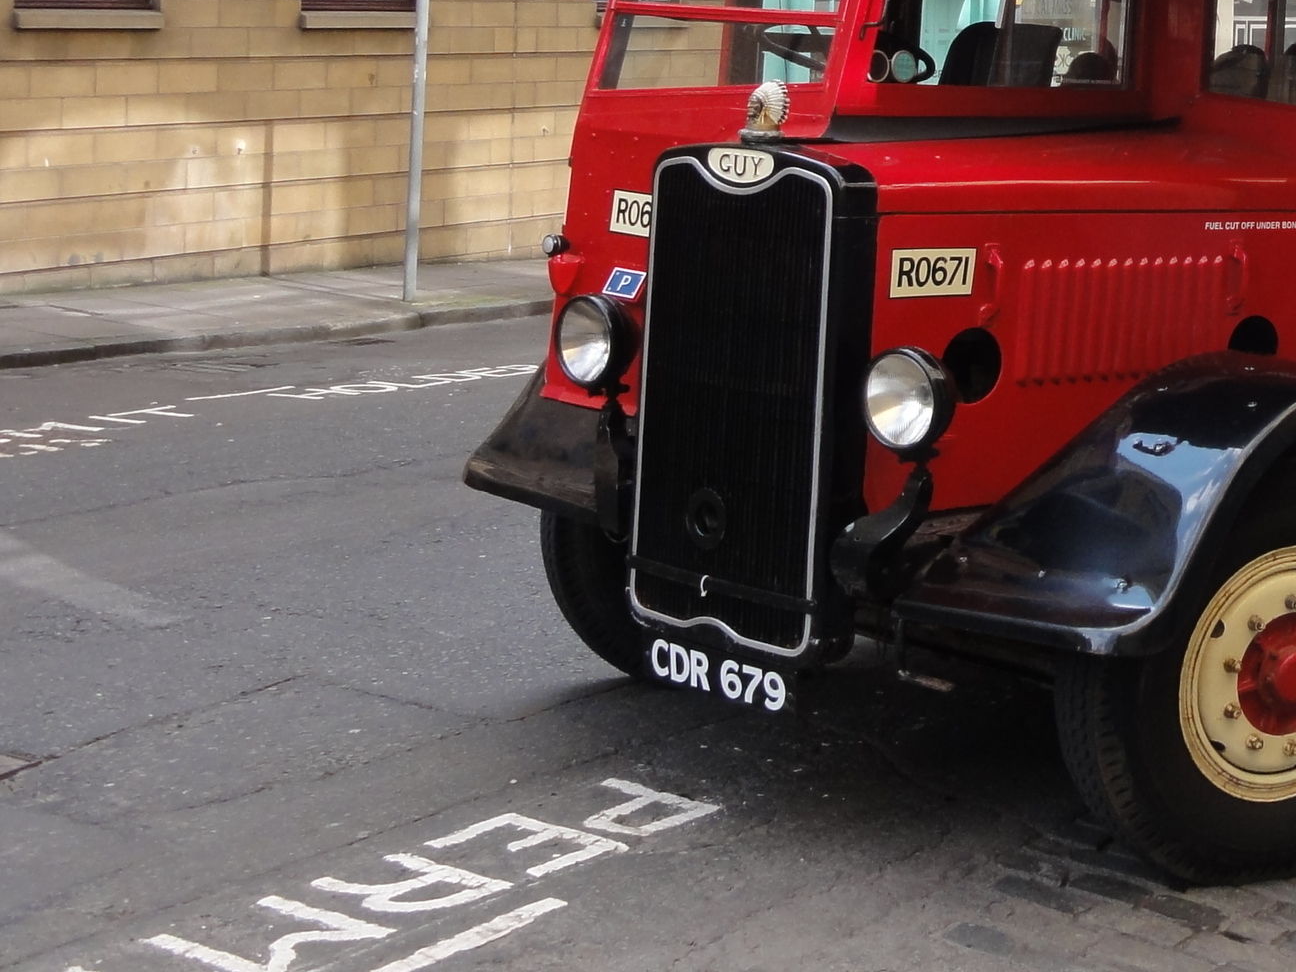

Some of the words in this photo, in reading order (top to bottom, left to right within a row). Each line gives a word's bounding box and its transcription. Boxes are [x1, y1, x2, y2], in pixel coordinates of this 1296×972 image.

[718, 152, 764, 178] GUY
[1204, 221, 1224, 231] FUEL
[1225, 221, 1241, 231] CUT
[1241, 221, 1256, 230] OFF
[1256, 221, 1281, 230] UNDER
[616, 275, 632, 291] P
[651, 638, 711, 692] CDR
[720, 659, 786, 711] 679
